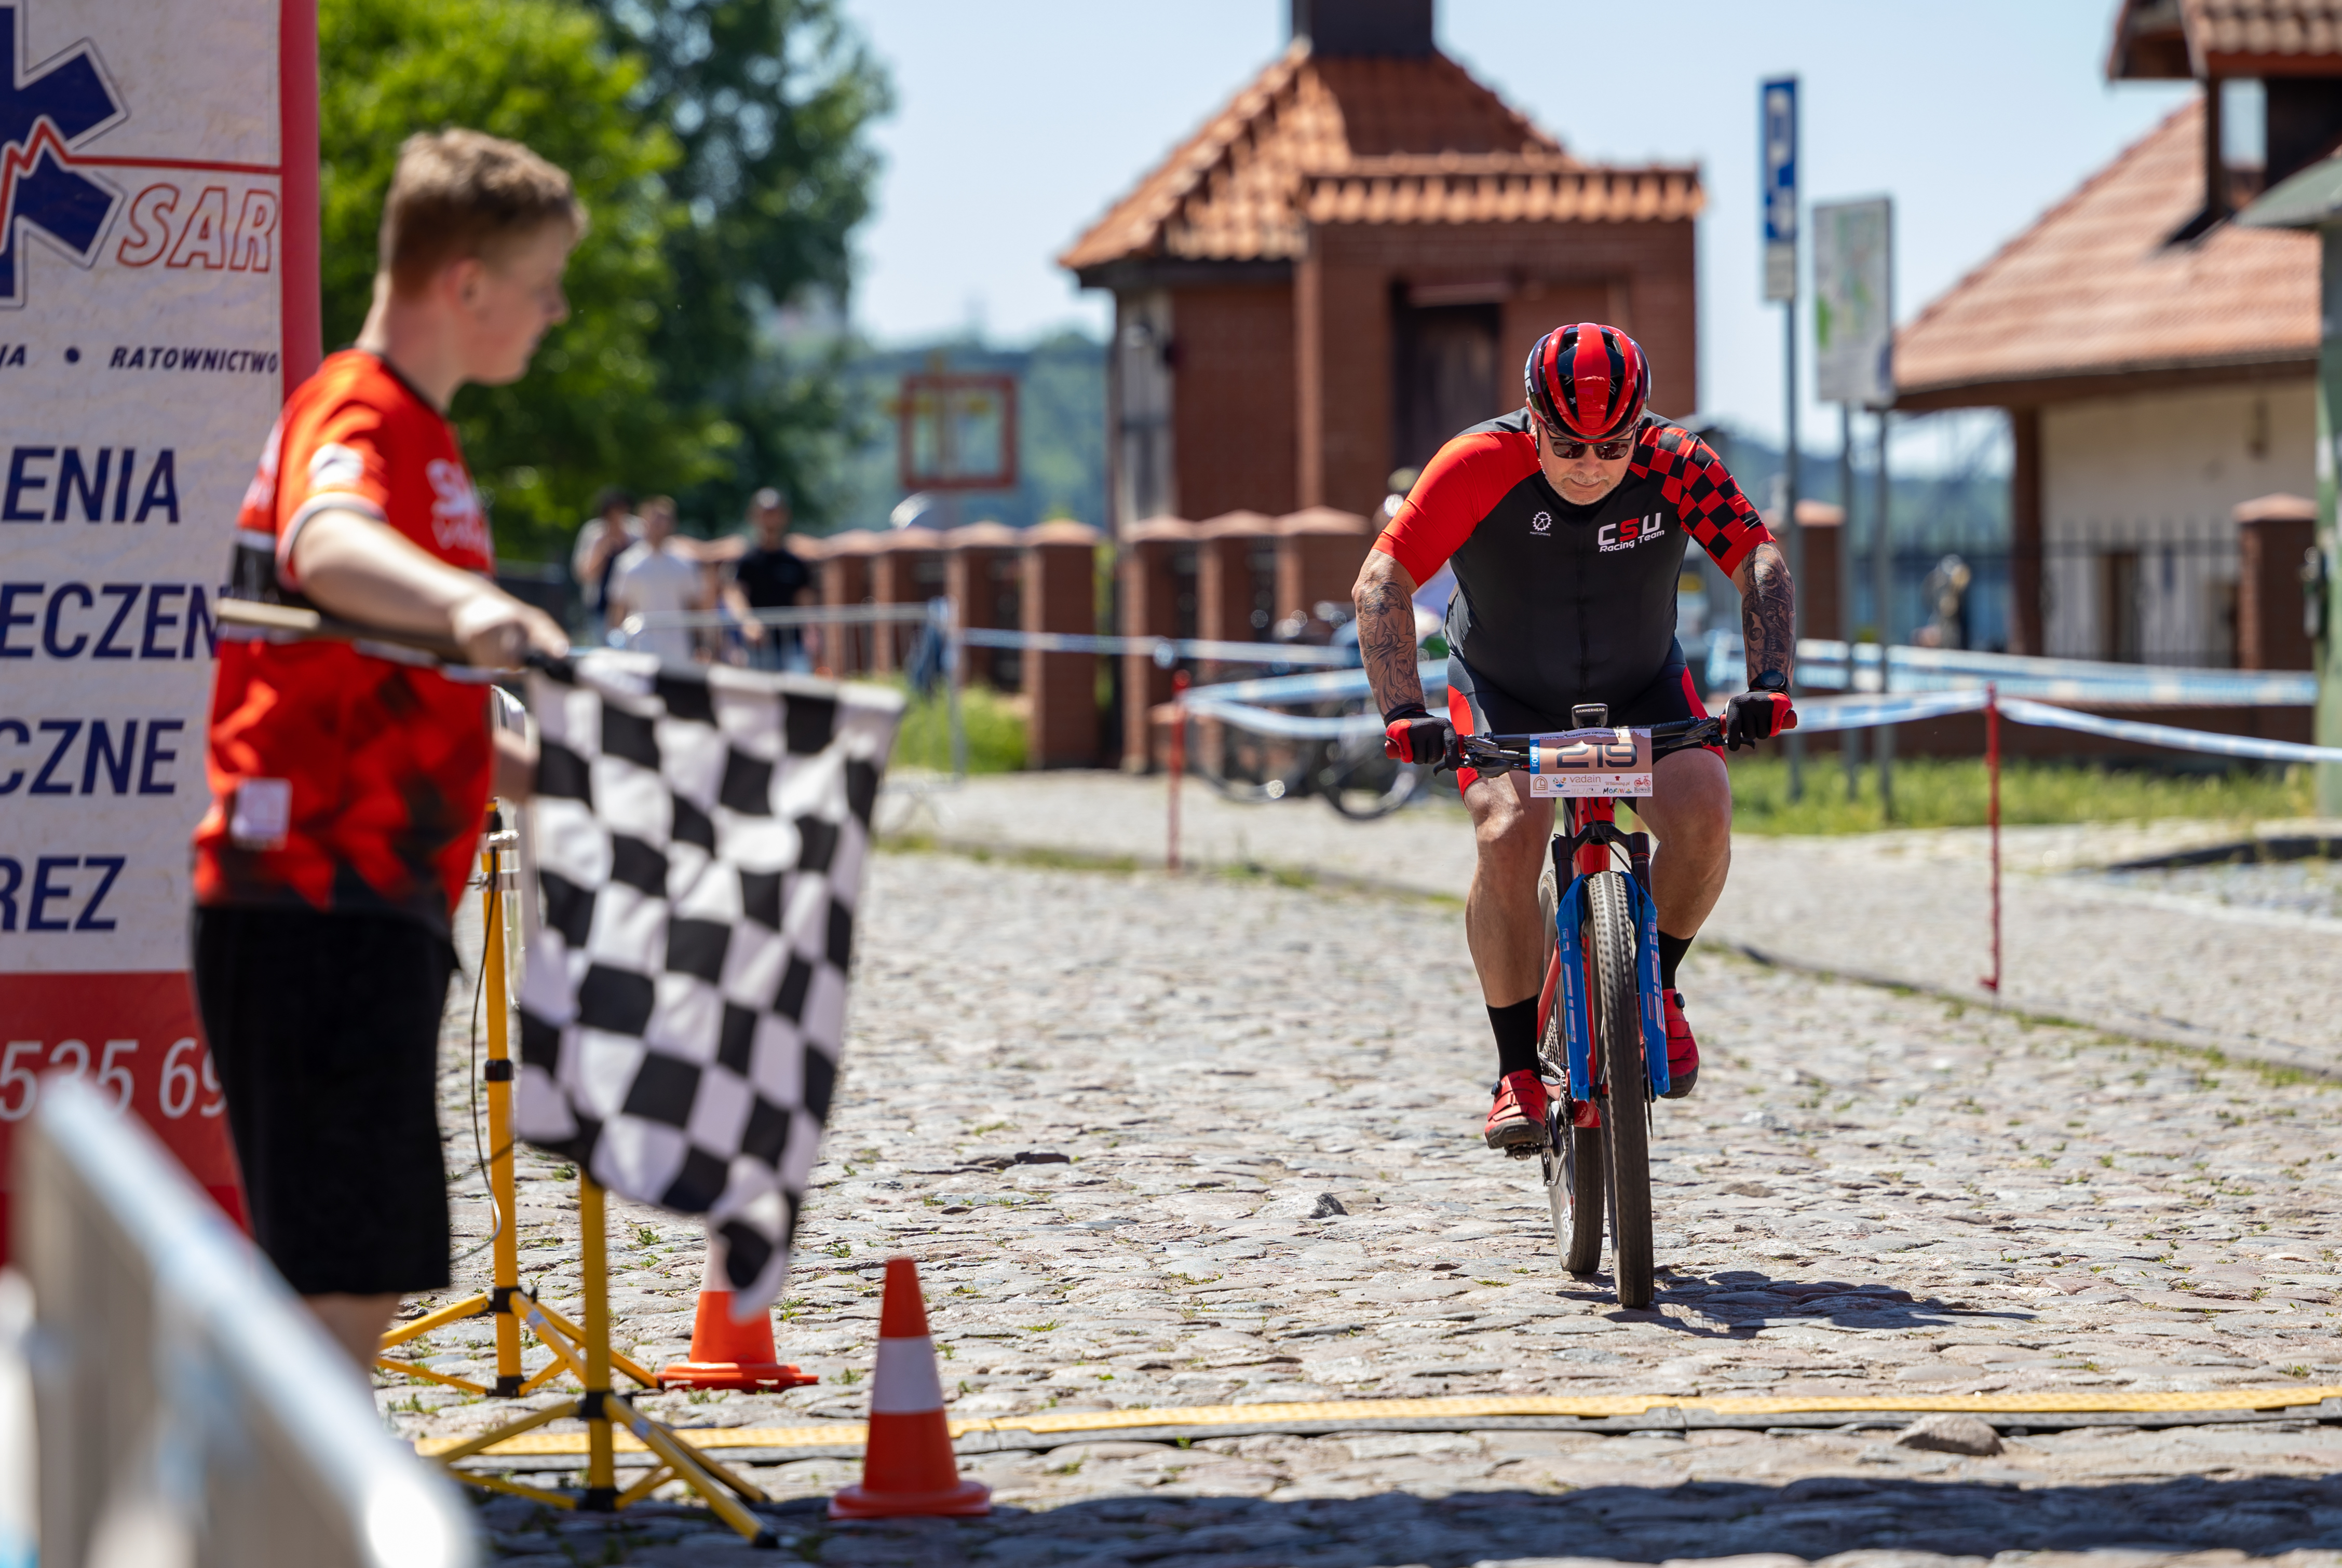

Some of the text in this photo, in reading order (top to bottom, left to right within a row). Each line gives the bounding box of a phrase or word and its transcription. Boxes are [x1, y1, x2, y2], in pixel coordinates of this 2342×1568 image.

[117, 183, 279, 272] SAR
[109, 346, 278, 374] RATOWNICTWO
[2, 445, 180, 524] ENIA
[1598, 512, 1661, 546] CSU
[1600, 530, 1664, 552] Racing Team
[1556, 742, 1637, 768] 219
[1569, 775, 1601, 783] vadain
